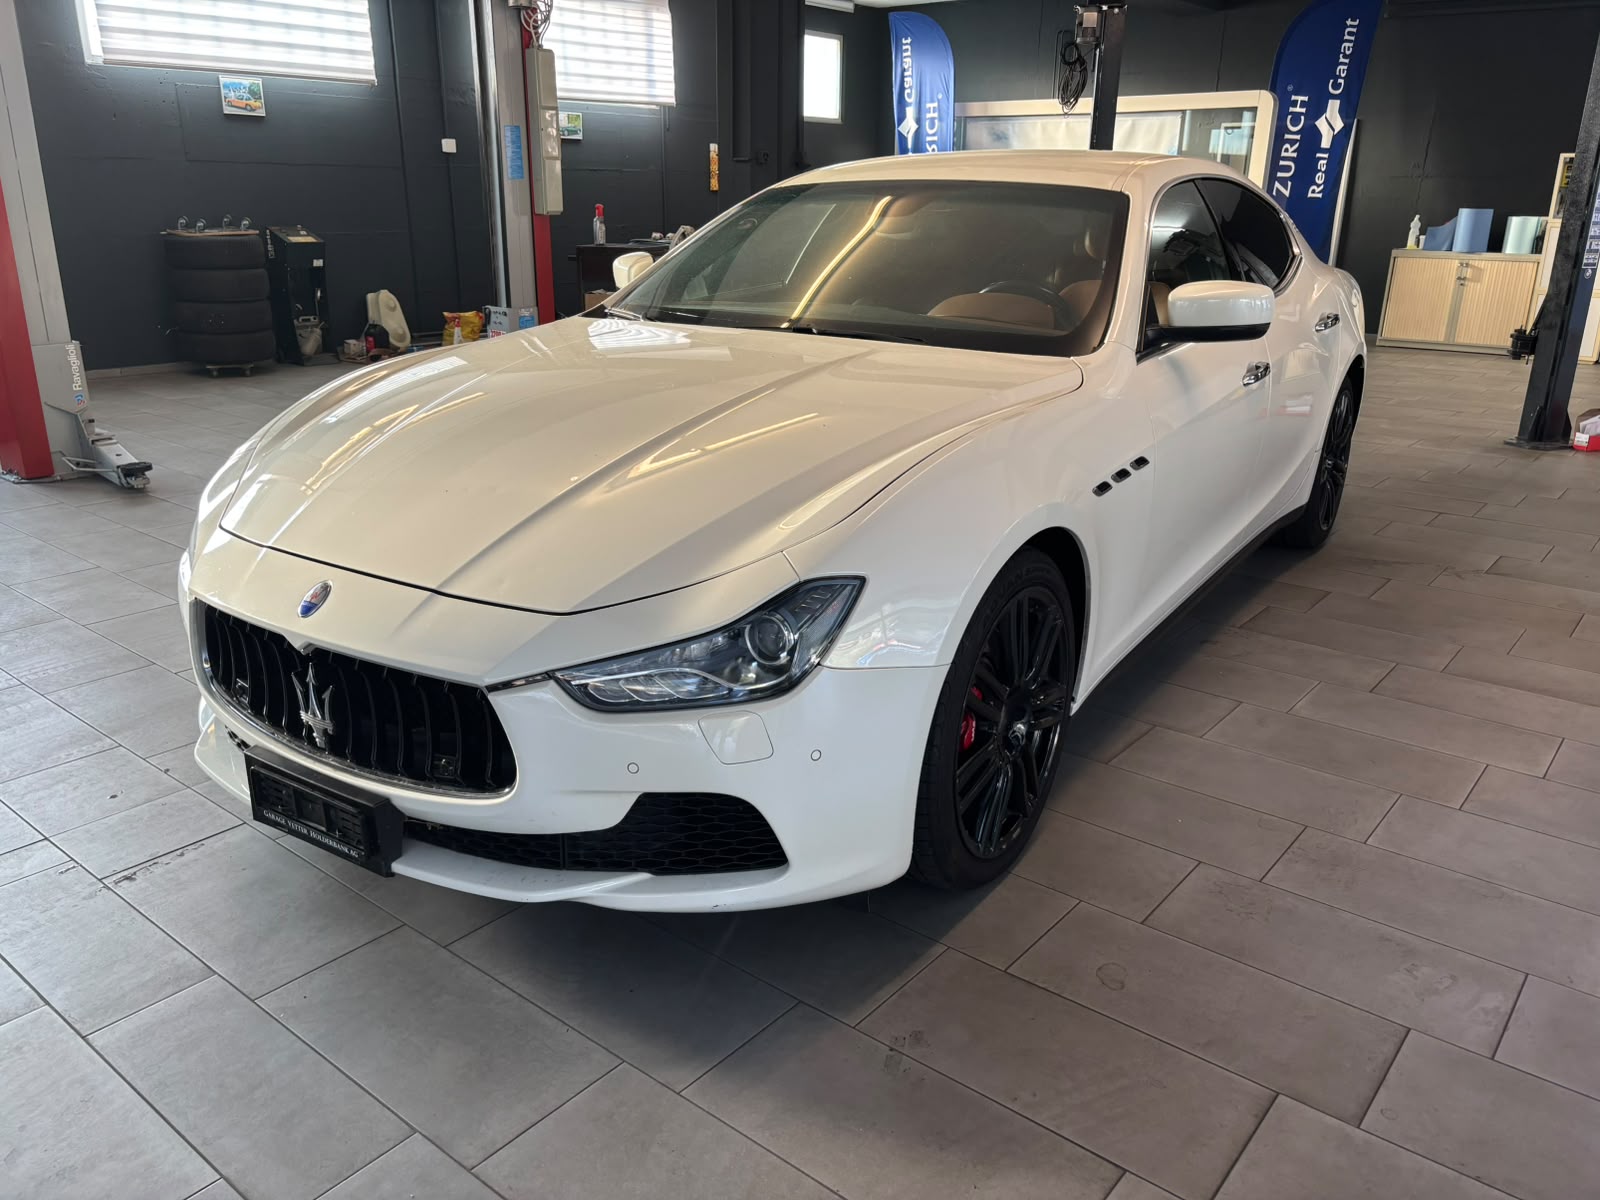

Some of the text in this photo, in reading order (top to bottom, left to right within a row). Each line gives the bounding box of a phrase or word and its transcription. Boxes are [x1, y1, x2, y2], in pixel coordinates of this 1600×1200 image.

[1307, 17, 1359, 198] Real Garant
[1272, 95, 1309, 198] ZURICH
[65, 344, 83, 391] Ravaglioli
[263, 809, 287, 825] GARAGE
